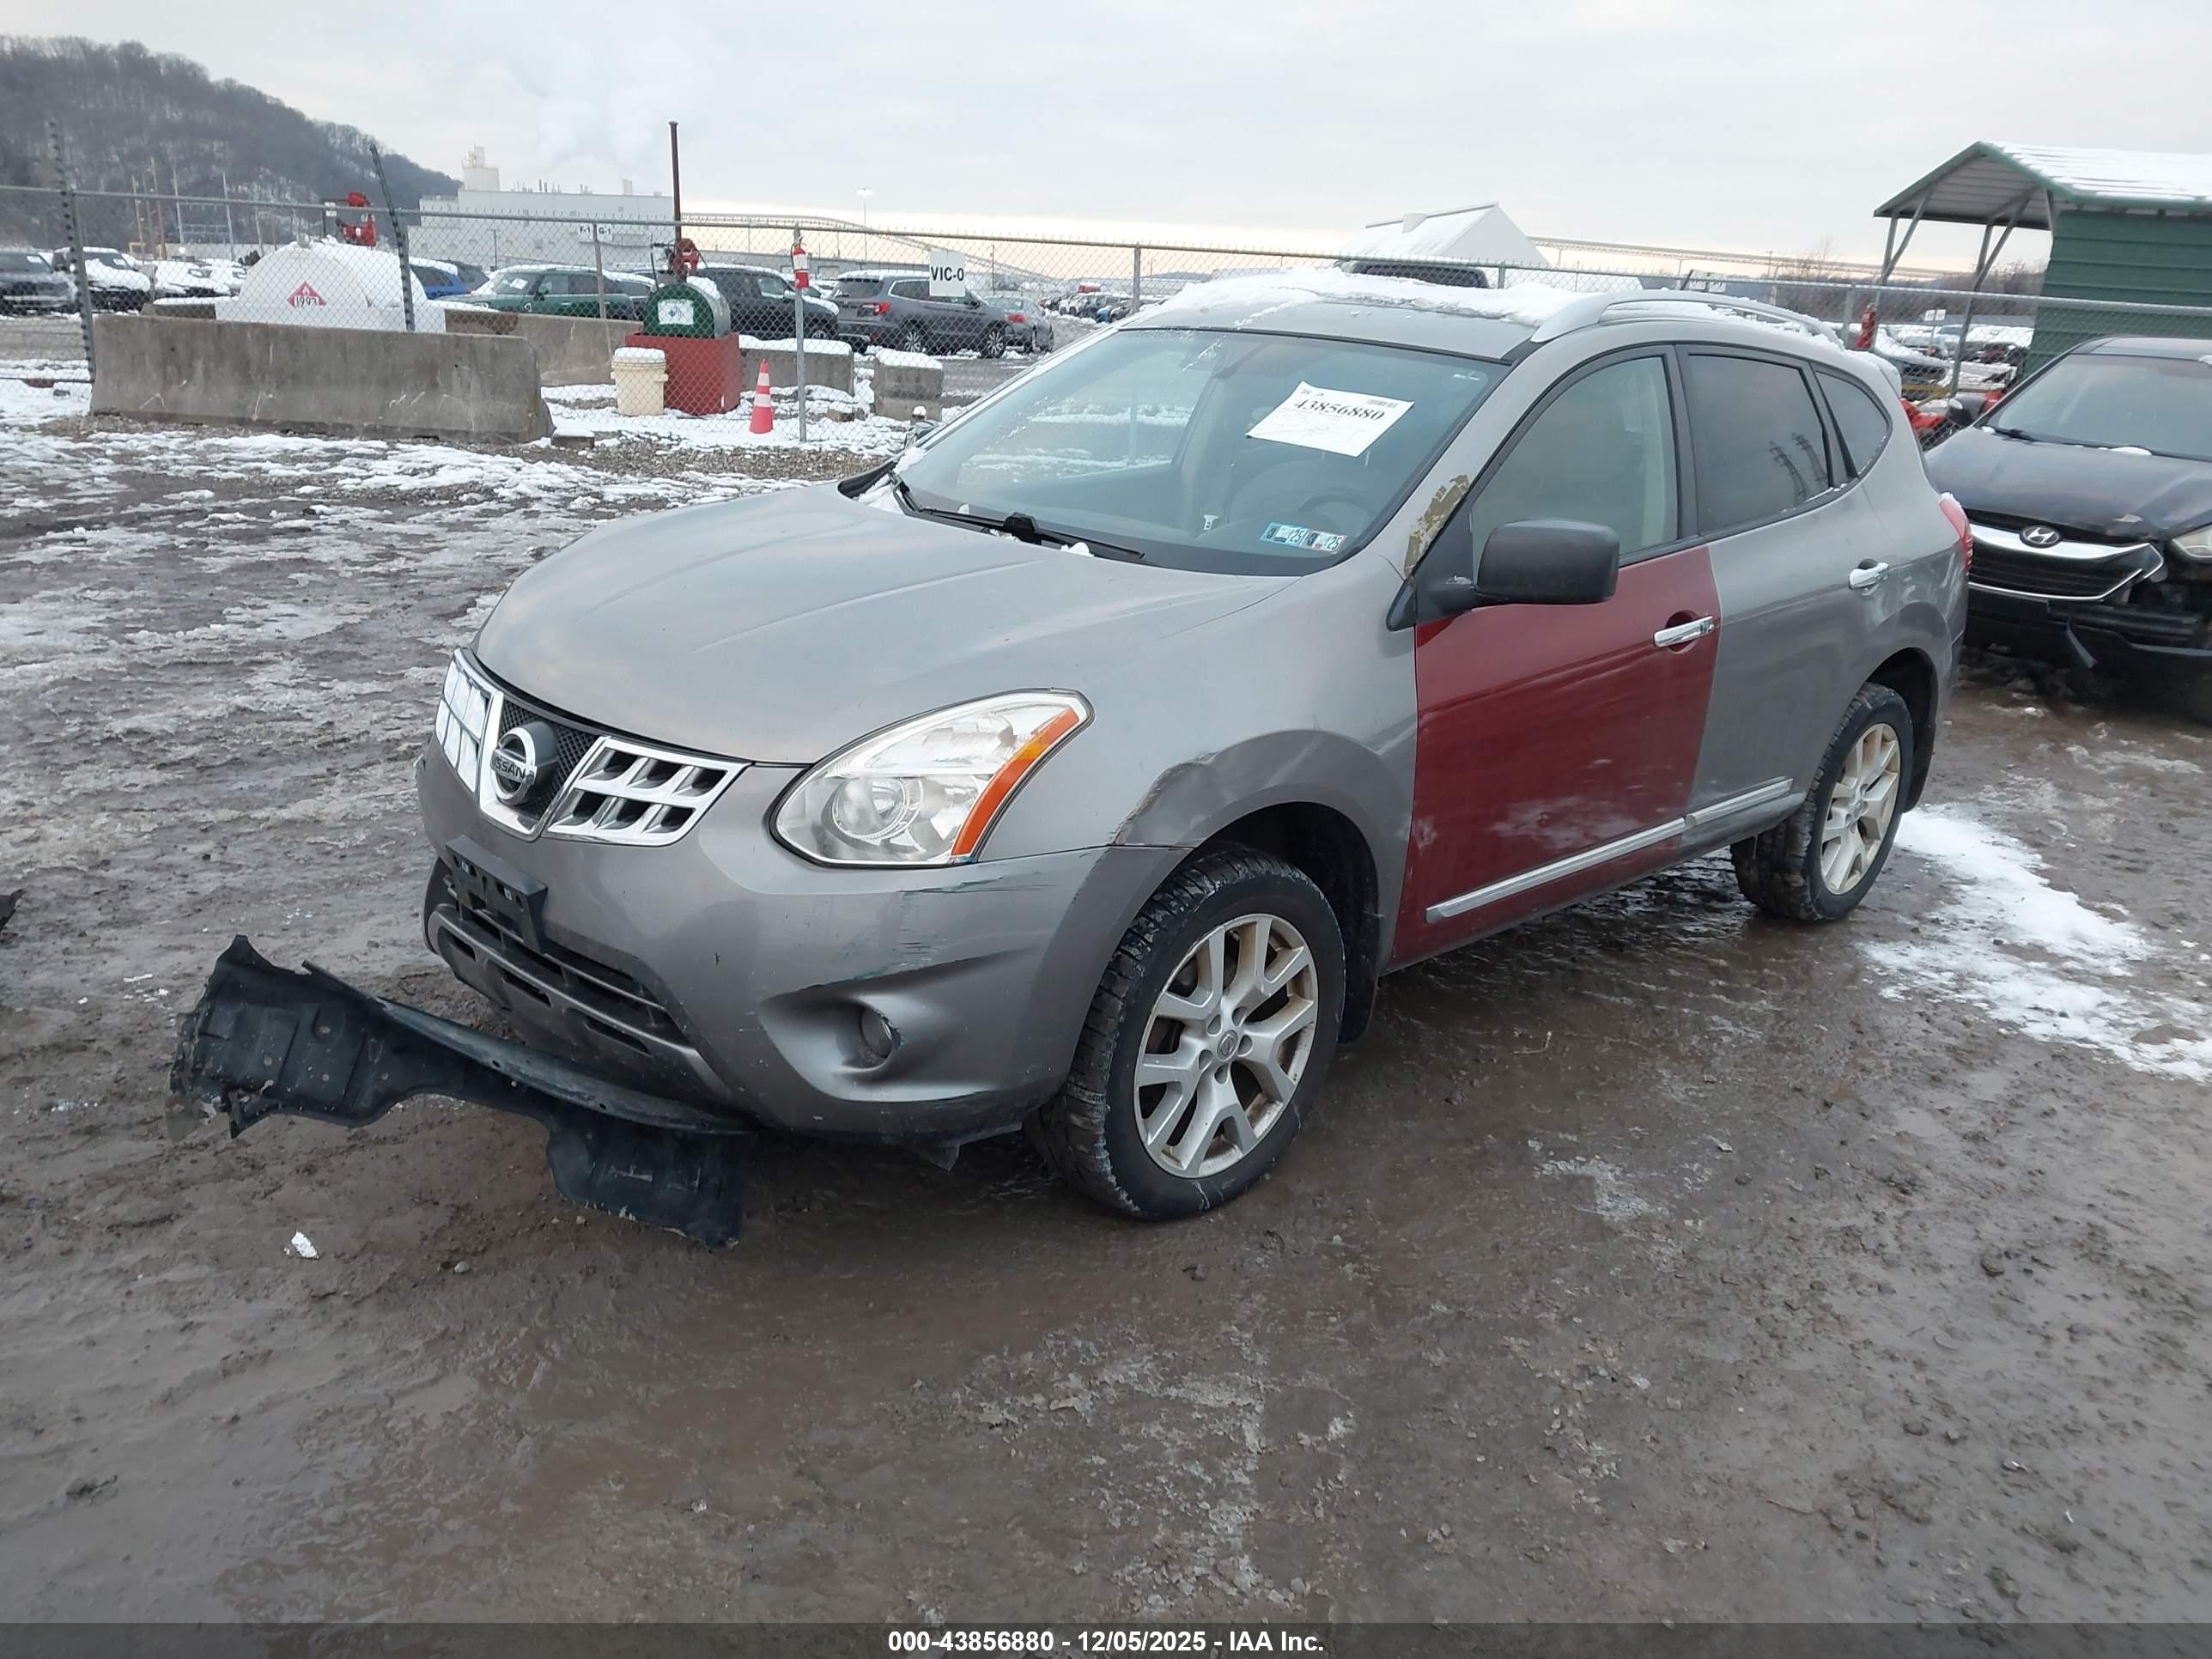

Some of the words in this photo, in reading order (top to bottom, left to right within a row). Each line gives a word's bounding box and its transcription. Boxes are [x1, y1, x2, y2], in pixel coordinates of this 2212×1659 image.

[295, 296, 318, 307] 1993
[1294, 399, 1385, 420] 43856880
[1290, 529, 1305, 543] 25
[1327, 536, 1342, 550] 25
